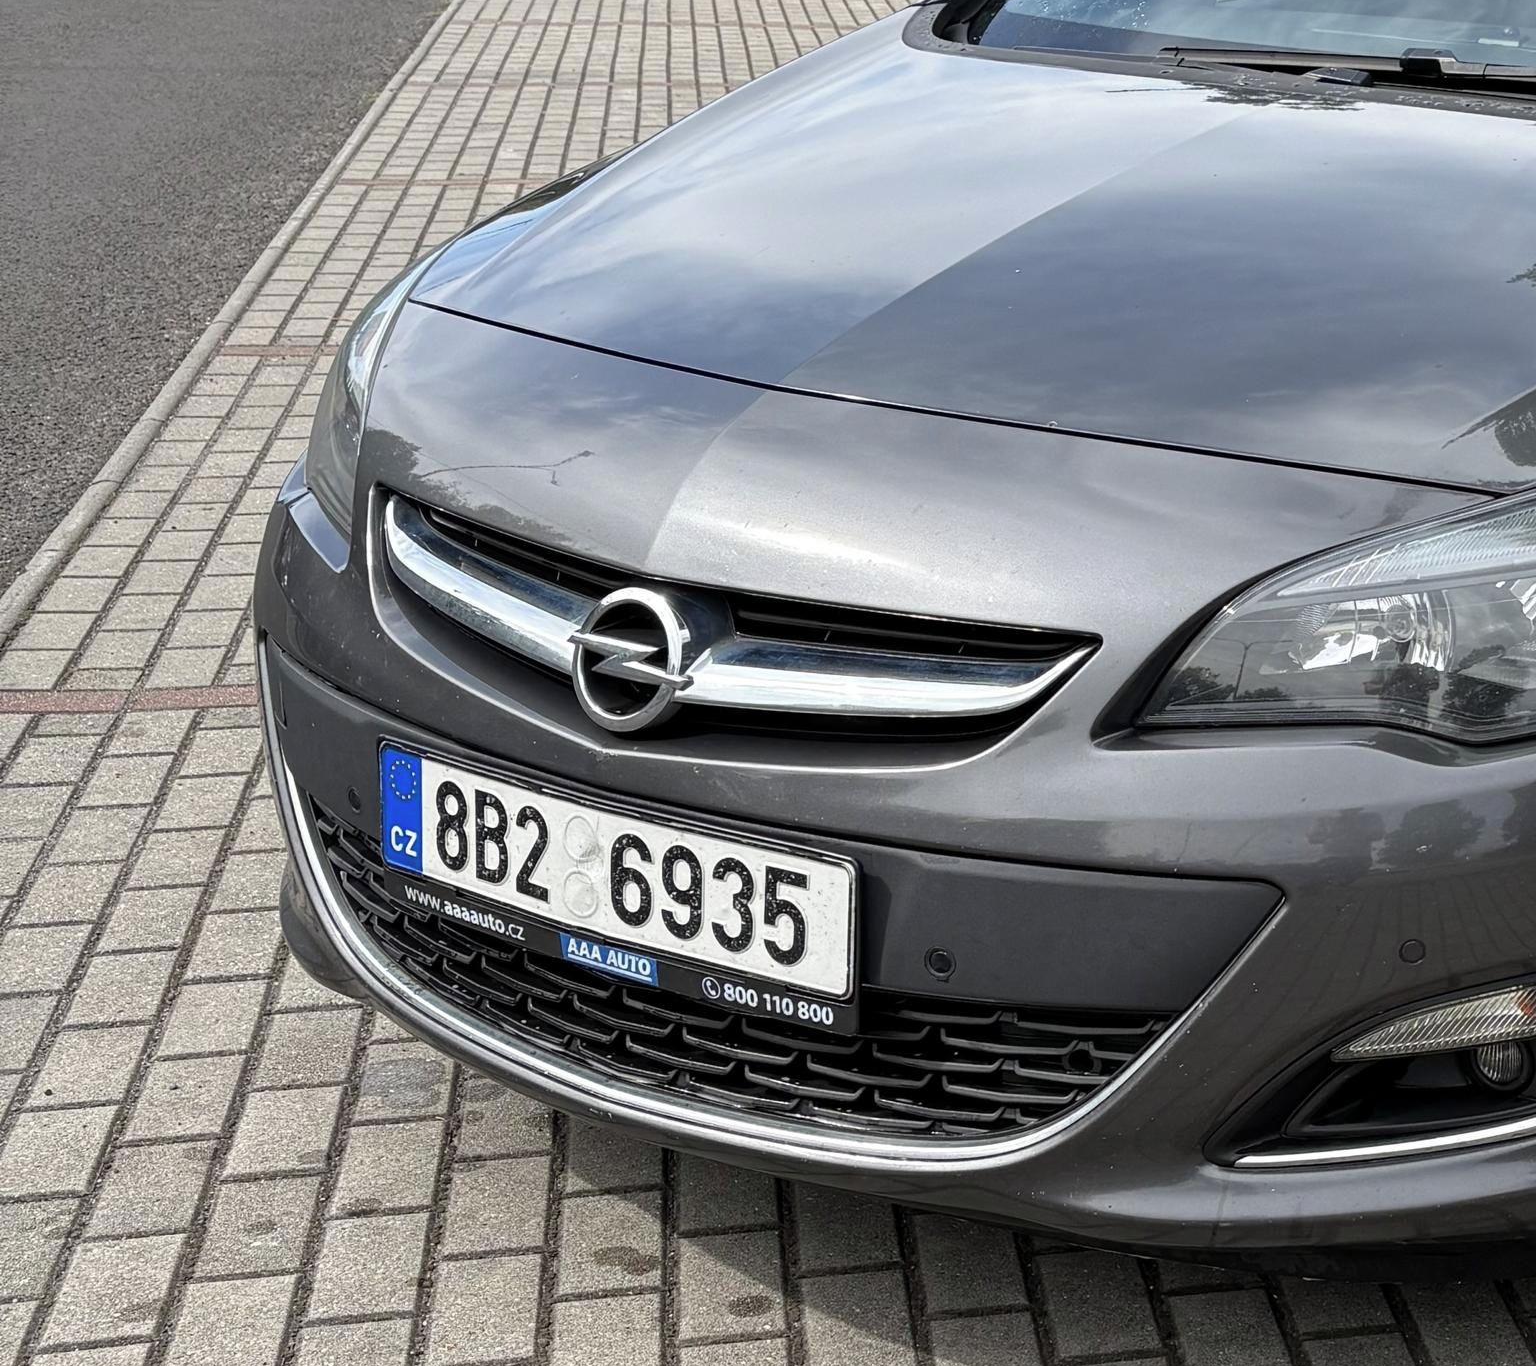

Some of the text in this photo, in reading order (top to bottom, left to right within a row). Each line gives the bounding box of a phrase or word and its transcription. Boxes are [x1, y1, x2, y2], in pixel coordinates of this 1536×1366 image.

[390, 825, 417, 857] CZ
[436, 780, 809, 966] 8B2 6935
[404, 884, 526, 941] www.aaaauto.cz
[567, 938, 651, 976] AAA AUTO
[723, 983, 834, 1025] 800 110 800
